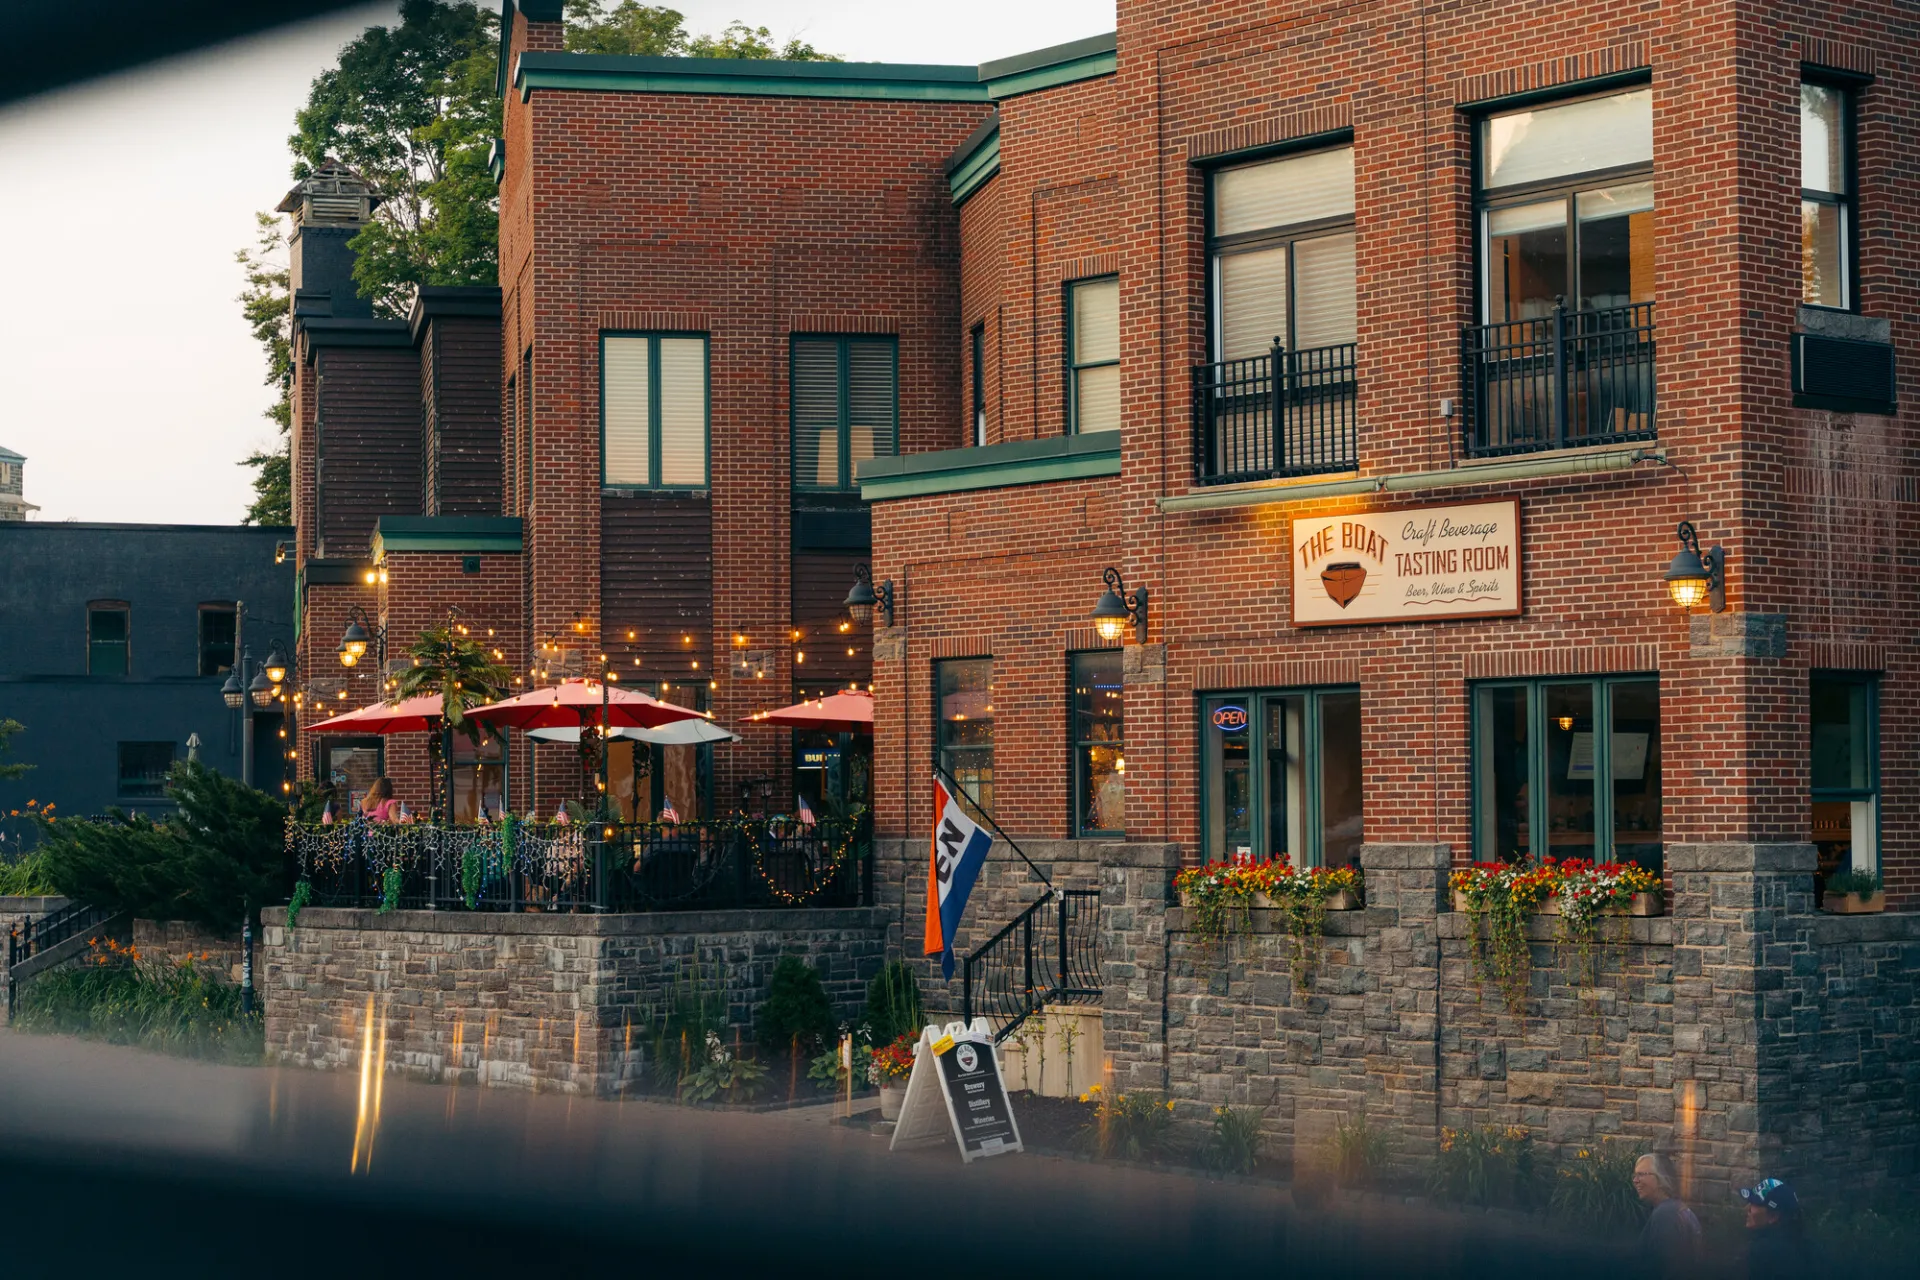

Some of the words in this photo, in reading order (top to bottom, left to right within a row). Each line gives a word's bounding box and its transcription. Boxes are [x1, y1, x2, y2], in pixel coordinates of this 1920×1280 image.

[1299, 525, 1335, 571] THE
[1342, 522, 1390, 565] BOAT
[1401, 518, 1436, 546] Craft
[1438, 518, 1498, 543] Beverage
[1395, 549, 1458, 577] TASTING
[1463, 545, 1509, 573] ROOM
[1431, 582, 1456, 596] Wine
[1466, 578, 1499, 598] Spirits
[1212, 711, 1247, 725] OPEN
[936, 817, 966, 884] EN
